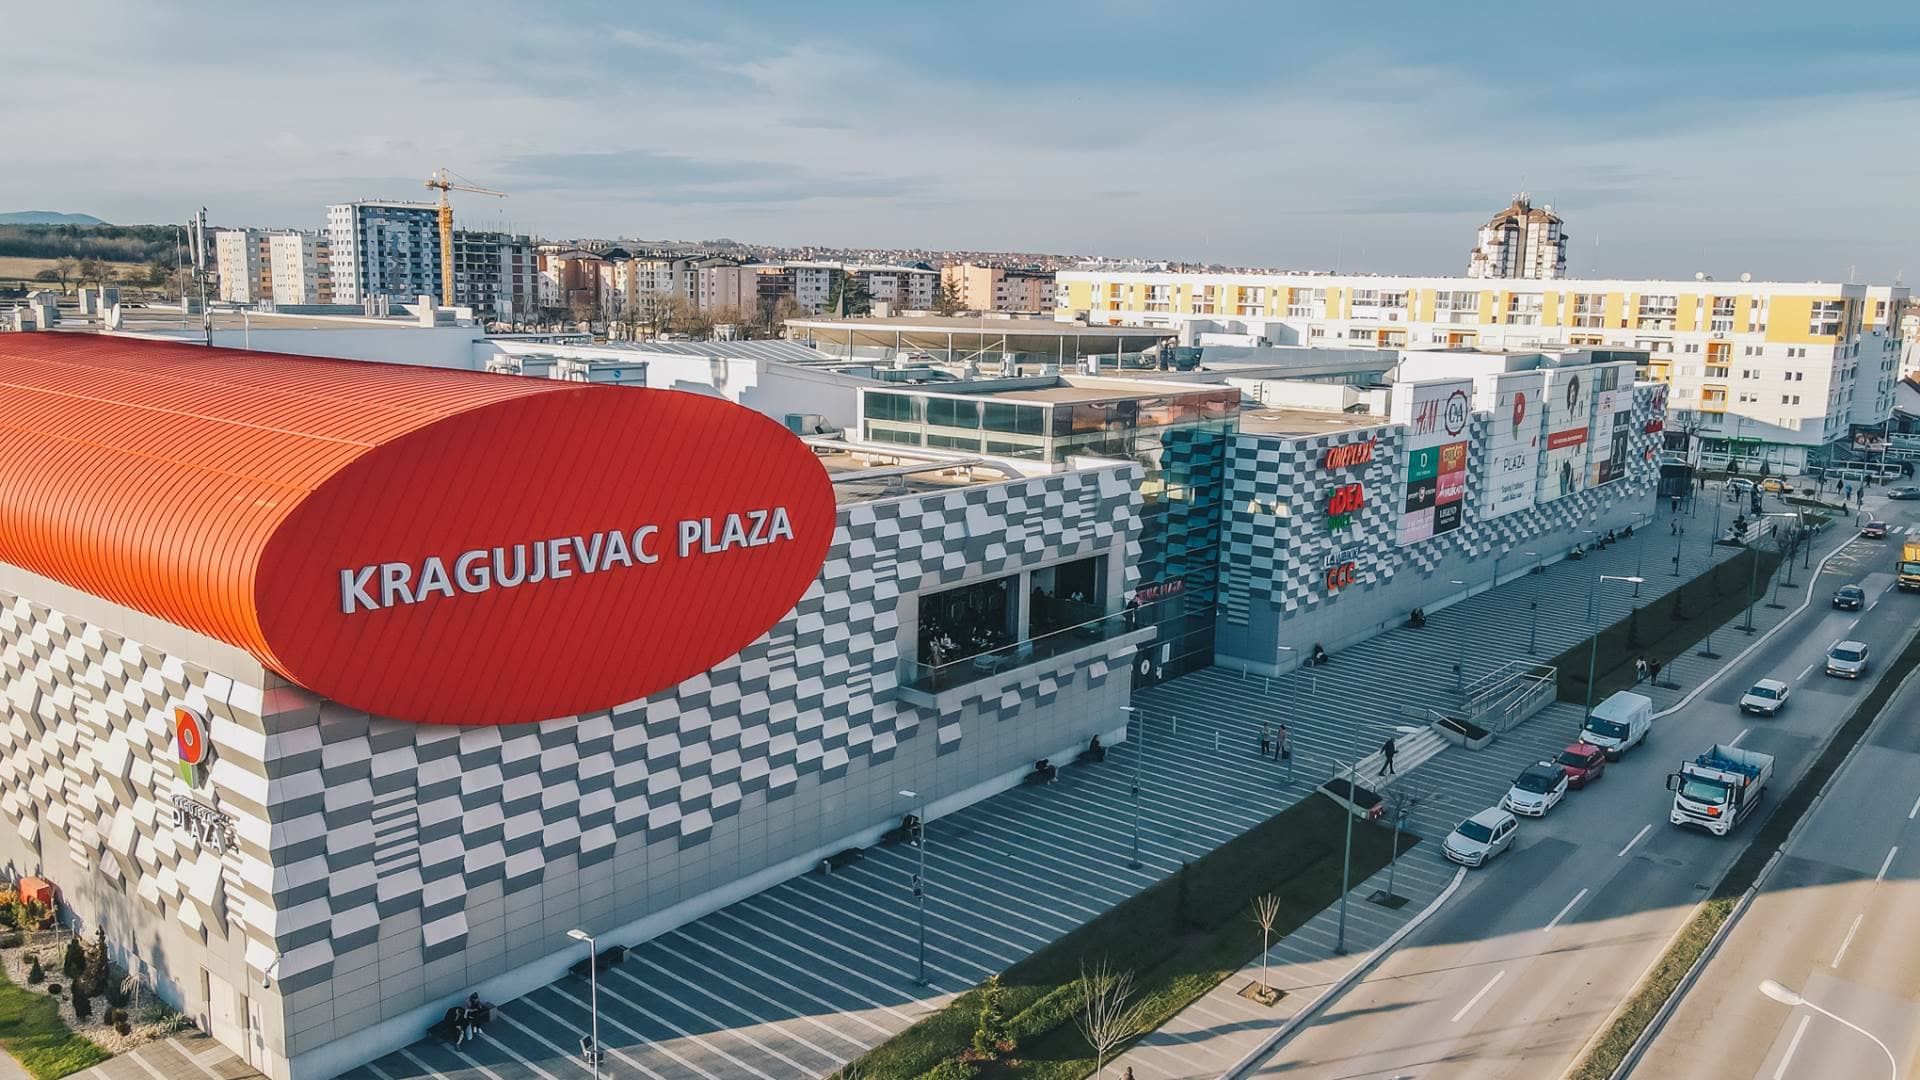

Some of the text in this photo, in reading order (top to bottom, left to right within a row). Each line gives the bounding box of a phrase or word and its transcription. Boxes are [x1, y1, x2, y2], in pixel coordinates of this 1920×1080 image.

[1503, 454, 1526, 472] PLAZA
[340, 506, 795, 615] KRAGUJEVAC PLAZA
[1327, 562, 1355, 590] CCC
[172, 810, 226, 856] PLAZA
